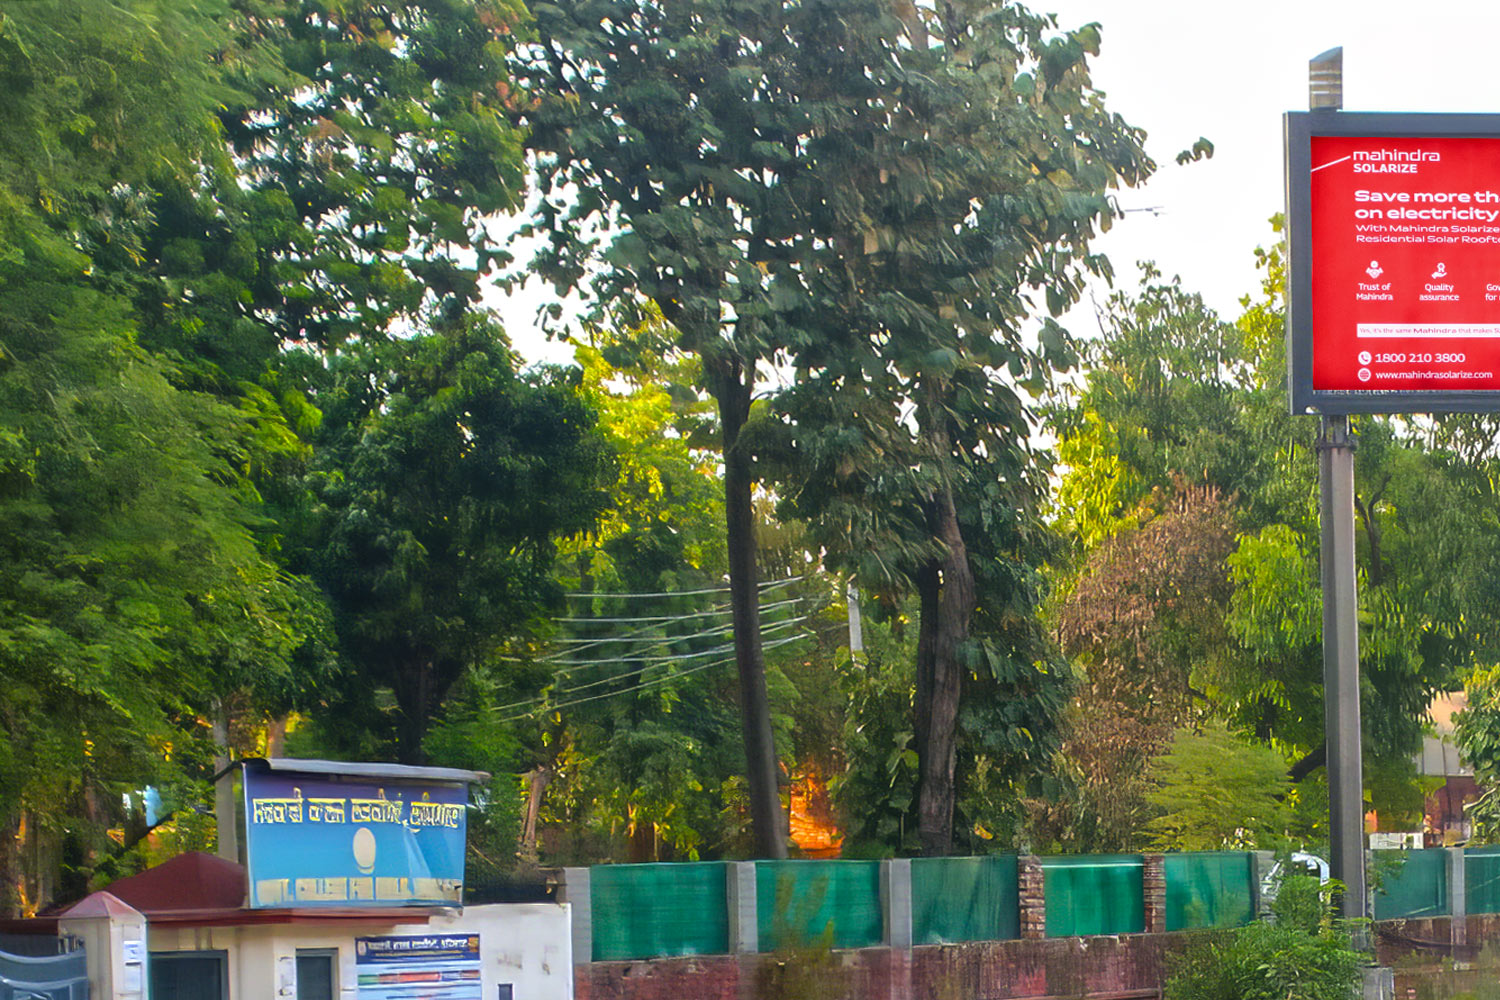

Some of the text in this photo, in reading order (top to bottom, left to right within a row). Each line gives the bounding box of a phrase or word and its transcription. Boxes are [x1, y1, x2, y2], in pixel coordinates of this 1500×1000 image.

[1353, 149, 1440, 162] mahindra
[1353, 163, 1418, 174] SOLARIZE
[1354, 190, 1410, 203] Save
[1413, 192, 1471, 204] more
[1354, 208, 1383, 220] on
[1386, 207, 1500, 223] electricity
[1355, 224, 1500, 234] With Mahindra Solarize
[1356, 235, 1425, 244] Residential
[1426, 235, 1460, 244] Solar
[1358, 283, 1392, 292] Trust of
[1424, 283, 1455, 293] Quality
[1356, 293, 1394, 301] Mahindra
[1419, 293, 1460, 301] assurance
[1485, 293, 1498, 301] for
[1374, 353, 1466, 364] 1800 210 3800
[1375, 370, 1493, 380] www.mahindrasolarize.com
